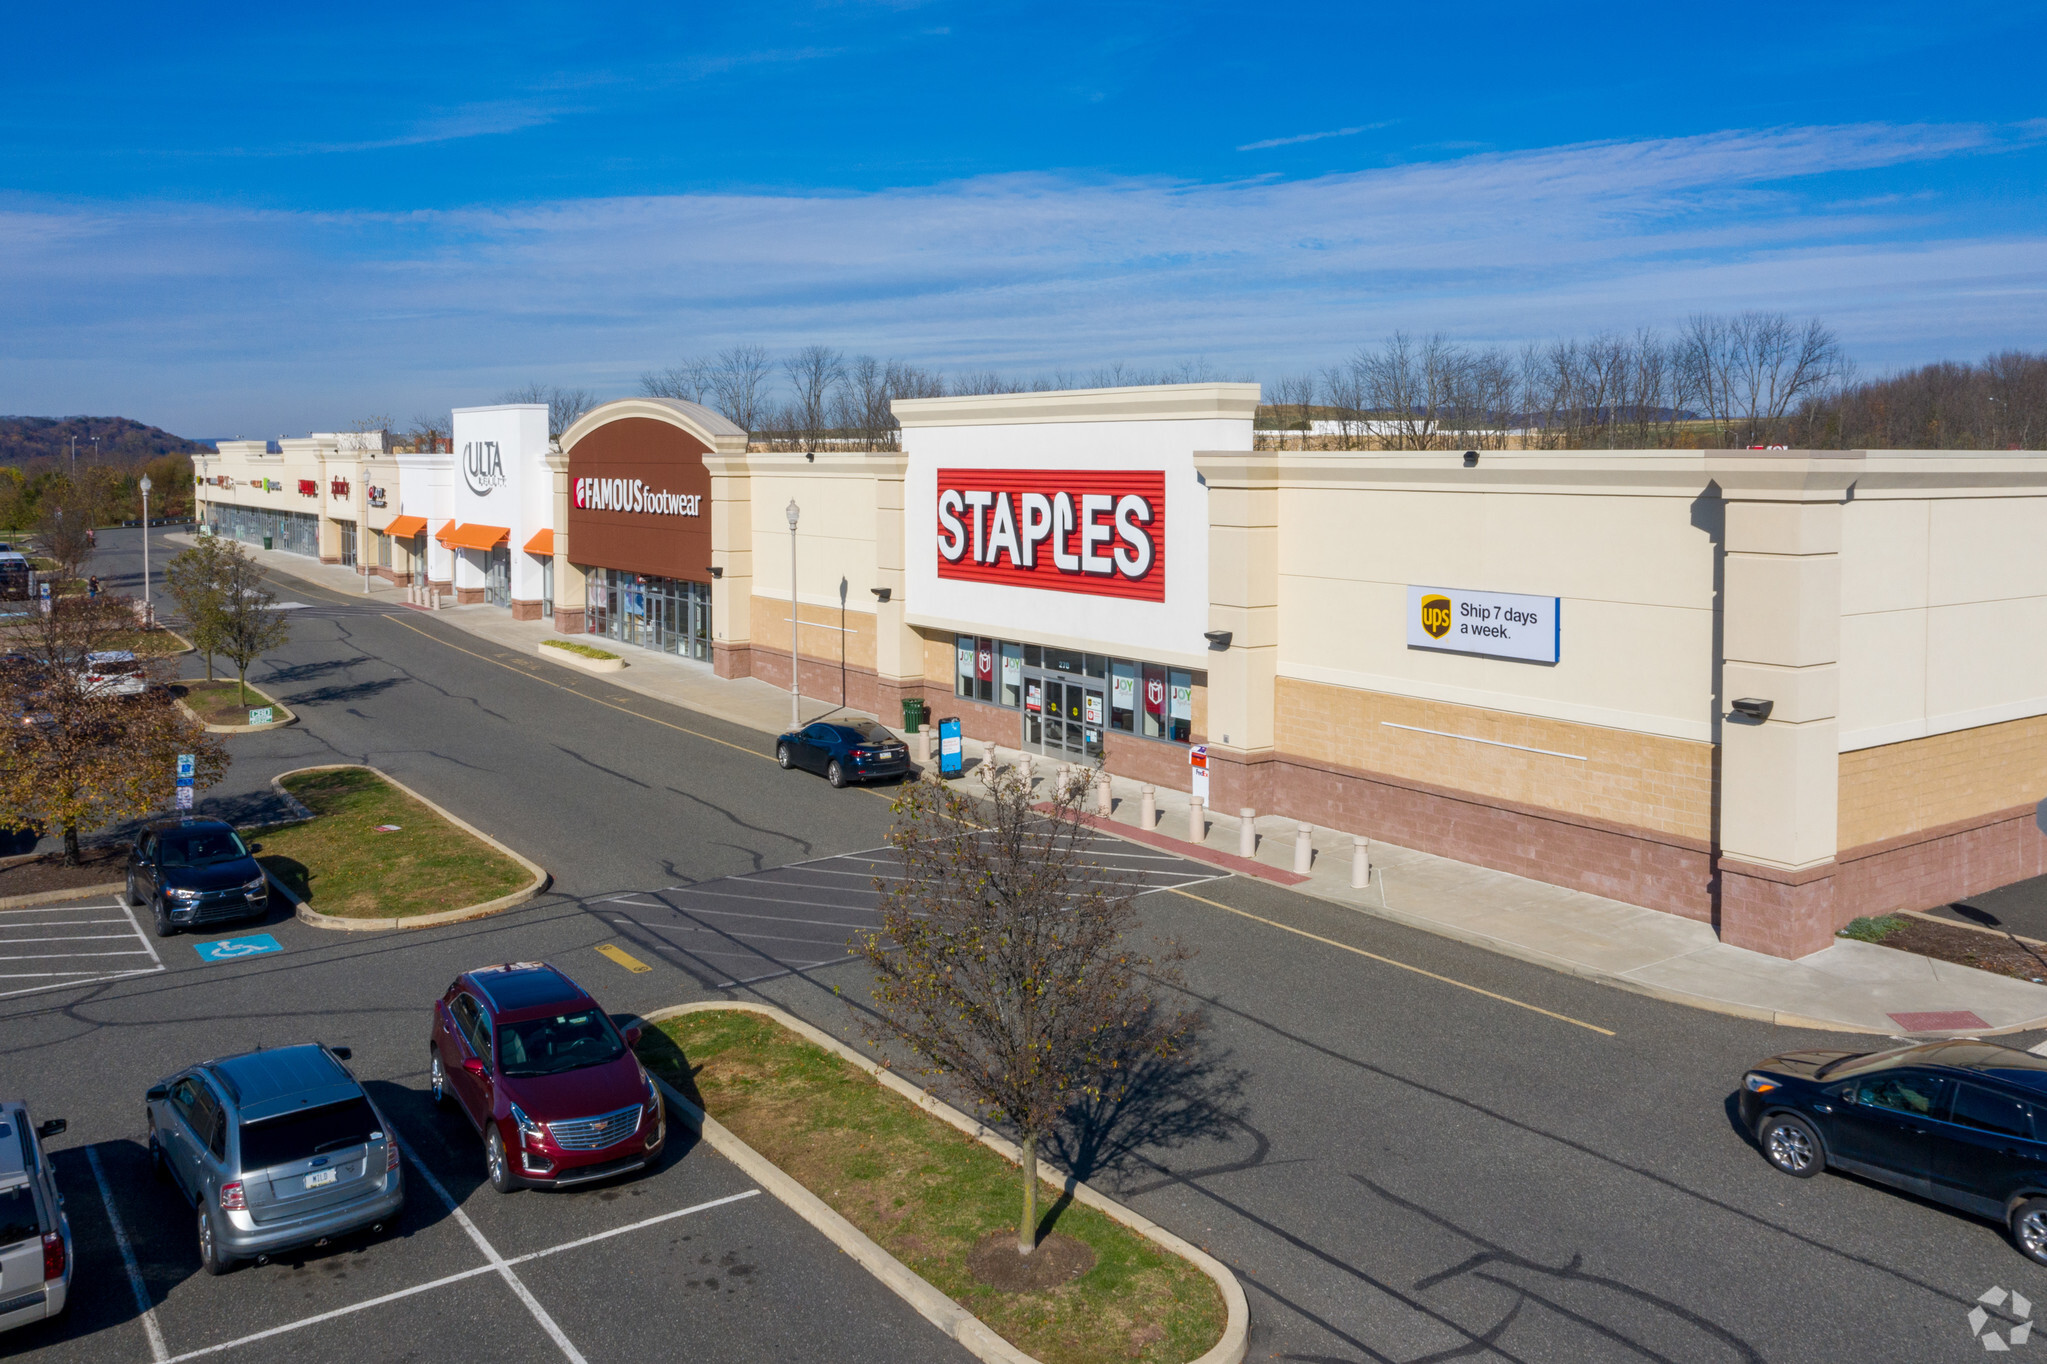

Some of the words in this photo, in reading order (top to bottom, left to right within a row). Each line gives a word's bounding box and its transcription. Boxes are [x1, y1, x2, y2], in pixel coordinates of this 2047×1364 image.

[468, 441, 504, 476] ULTA
[585, 477, 642, 512] FAMOUS
[642, 486, 702, 517] footwear
[937, 489, 1153, 578] STAPLES
[1423, 607, 1449, 633] ups
[1460, 602, 1491, 621] Ship
[1493, 606, 1501, 619] 7
[1504, 607, 1538, 626] days
[1460, 624, 1468, 634] a
[1471, 624, 1511, 639] week.
[960, 651, 973, 662] JOY
[1005, 657, 1020, 669] JOY
[1115, 678, 1133, 692] JOY
[1173, 687, 1191, 700] JOY
[1196, 769, 1209, 778] FedEx
